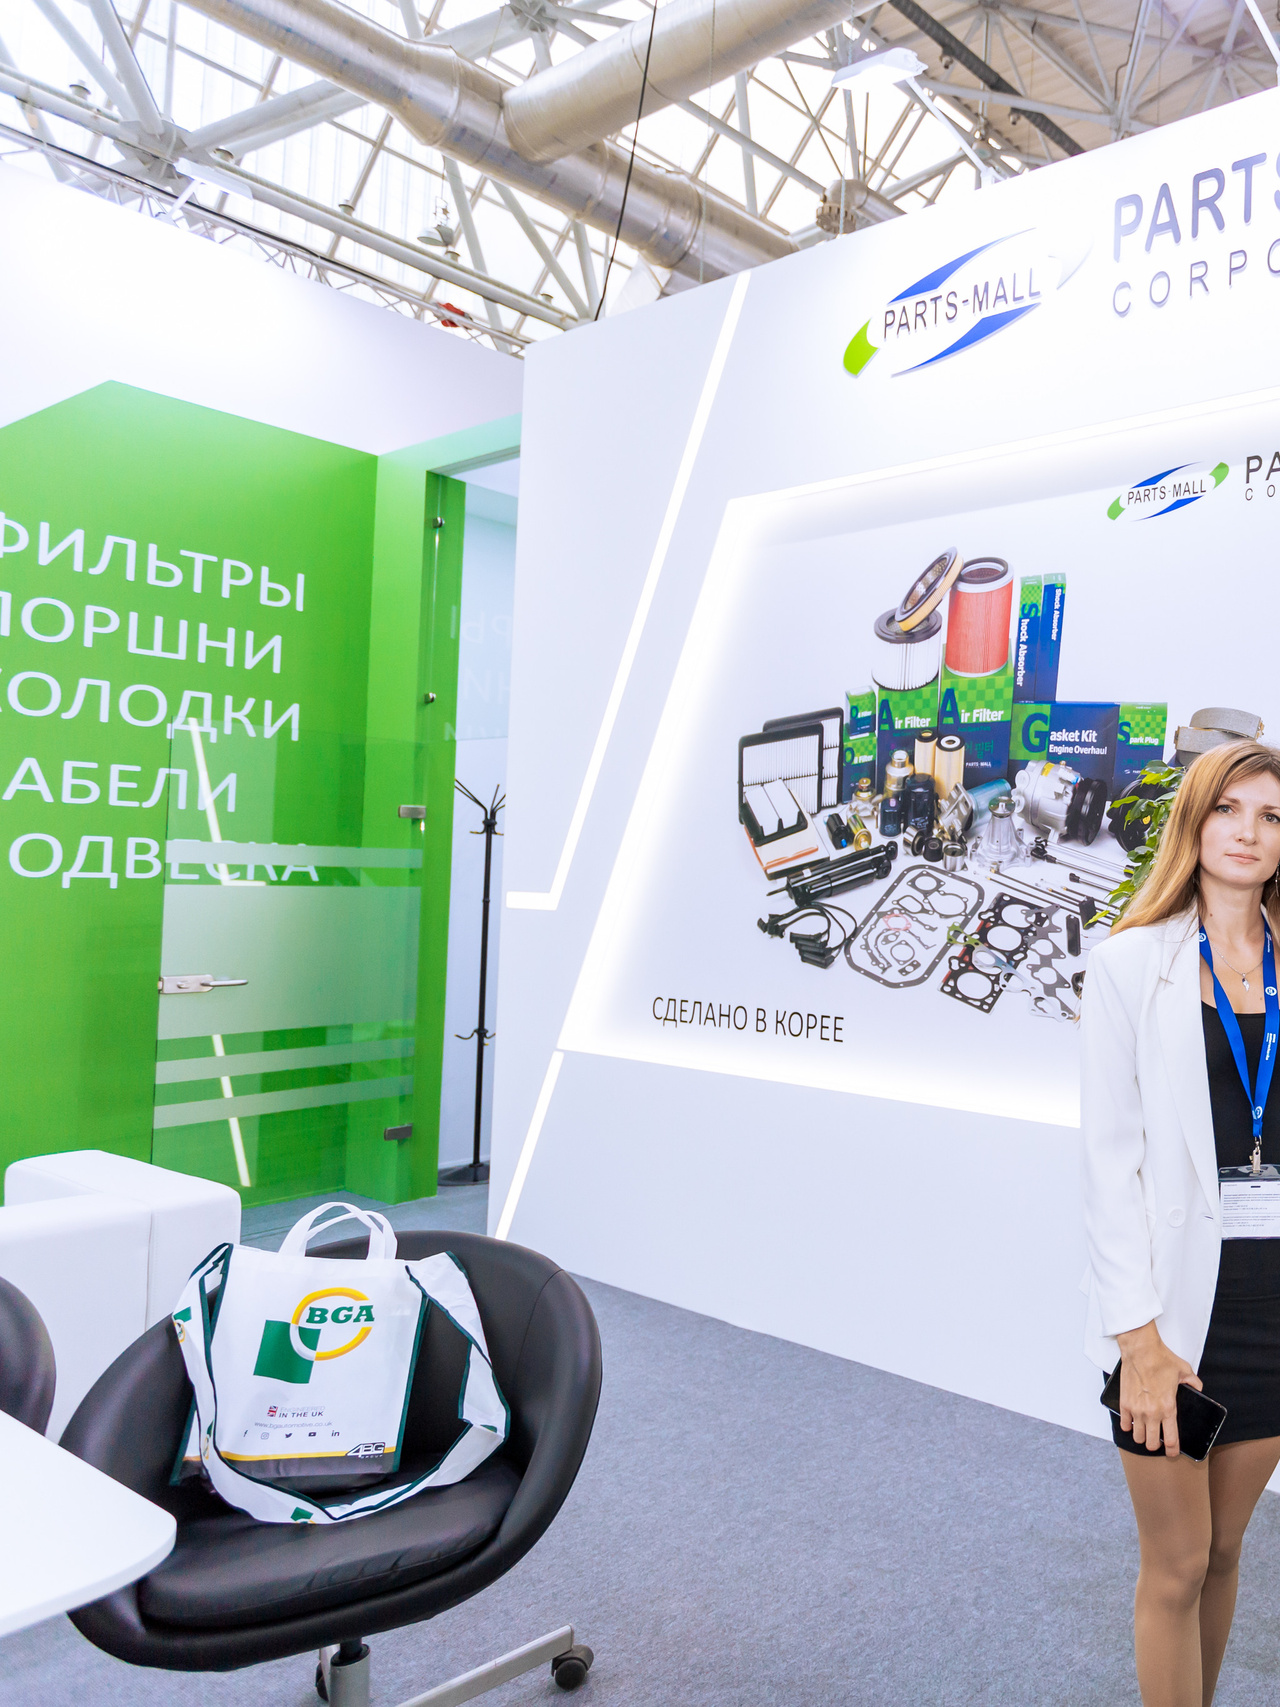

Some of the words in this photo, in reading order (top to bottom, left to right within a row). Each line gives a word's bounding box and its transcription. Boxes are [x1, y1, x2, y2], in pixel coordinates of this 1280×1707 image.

[884, 268, 1041, 340] PARTS-MALL
[1127, 479, 1207, 505] PARTS-MALL
[1016, 644, 1028, 687] Absorber
[0, 668, 300, 743] ОЛОДКИ
[972, 708, 1004, 722] Filter
[905, 717, 931, 728] Filter
[1081, 730, 1098, 742] Kit
[1145, 737, 1159, 745] Plug
[1049, 744, 1073, 755] Engine
[1074, 745, 1107, 755] Overhaul
[652, 996, 748, 1031] СДЕЛАНО
[755, 1007, 767, 1033] В
[775, 1009, 844, 1043] КОРЕЕ
[306, 1305, 375, 1324] BGA
